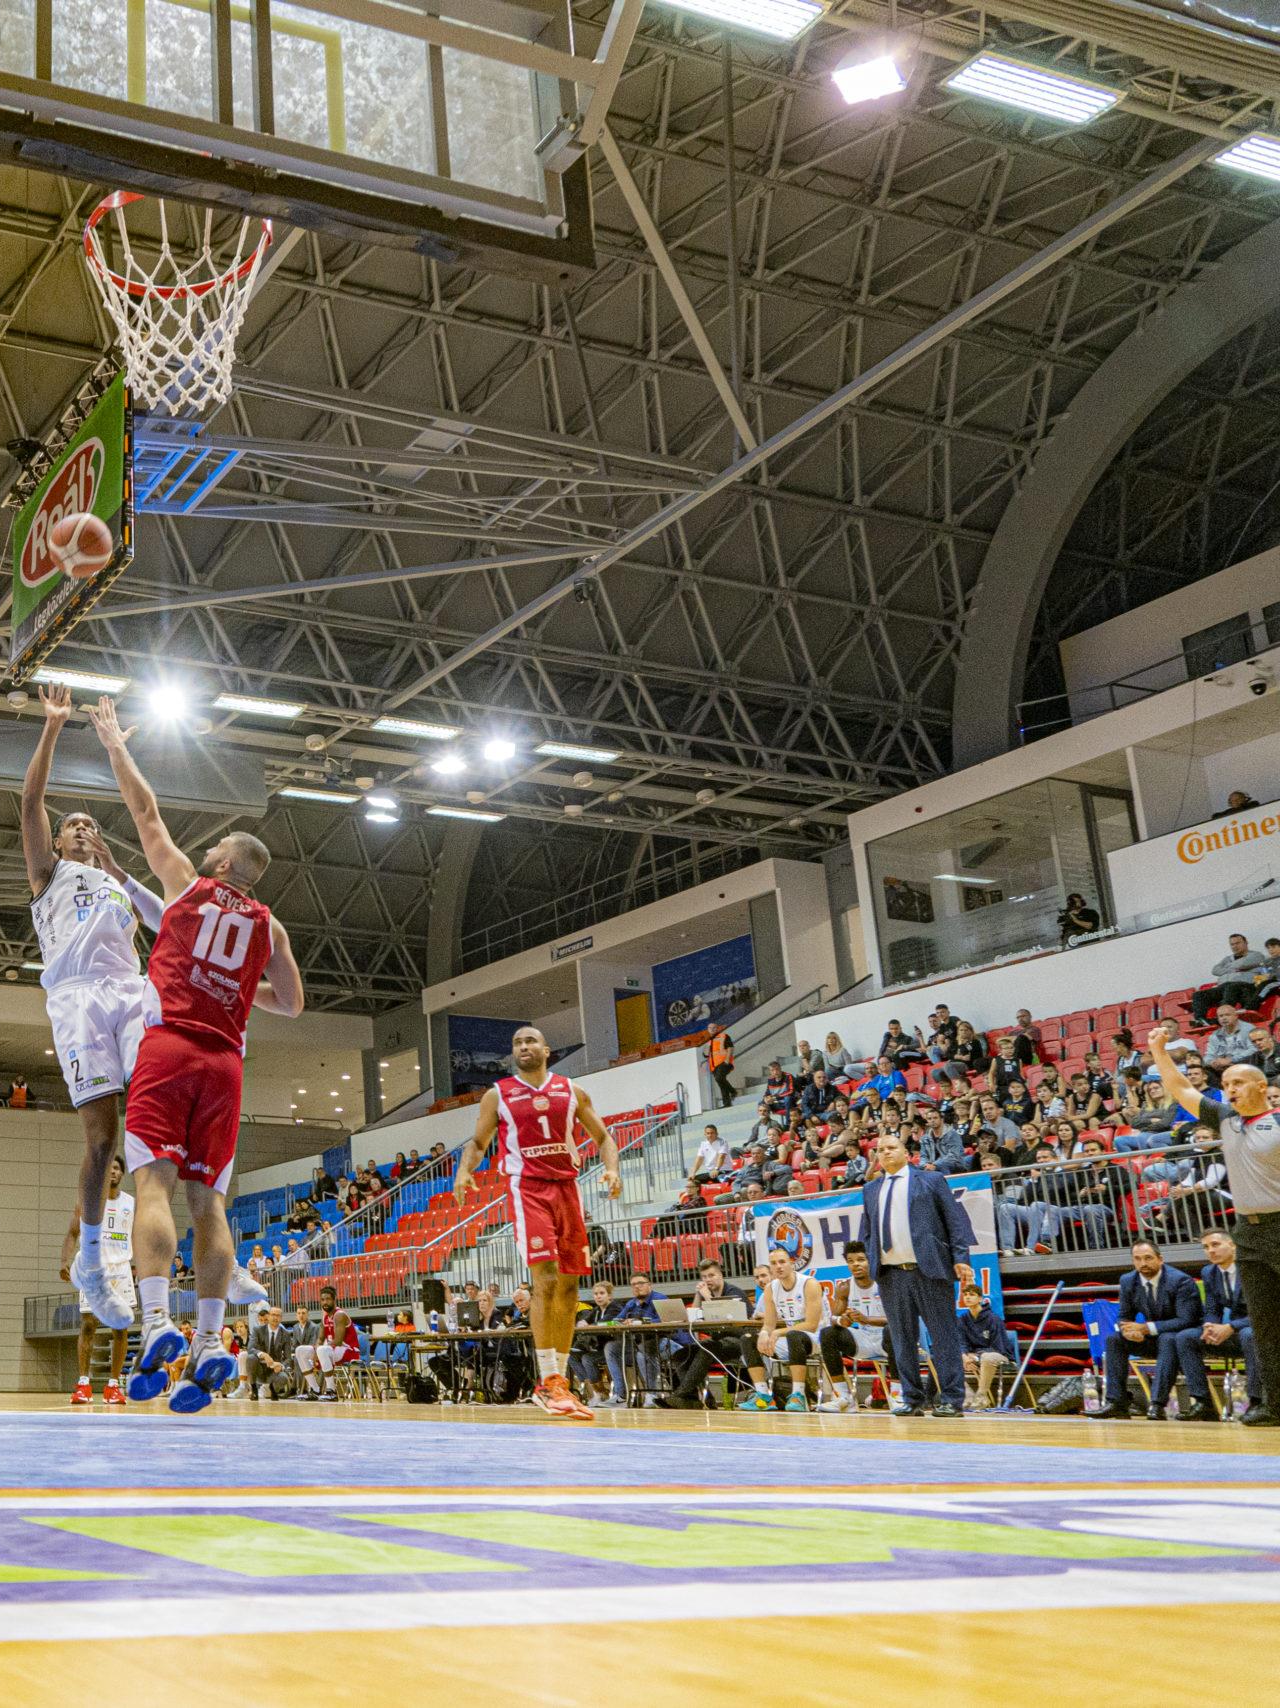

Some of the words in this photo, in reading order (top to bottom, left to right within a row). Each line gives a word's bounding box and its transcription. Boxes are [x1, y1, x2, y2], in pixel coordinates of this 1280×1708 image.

[31, 453, 87, 574] Reál
[1177, 814, 1280, 864] Contine
[192, 902, 254, 971] 10
[1068, 927, 1114, 947] Continental
[71, 1059, 84, 1083] 2
[538, 1115, 552, 1139] 1
[108, 1217, 114, 1229] 0
[582, 1246, 591, 1268] 1
